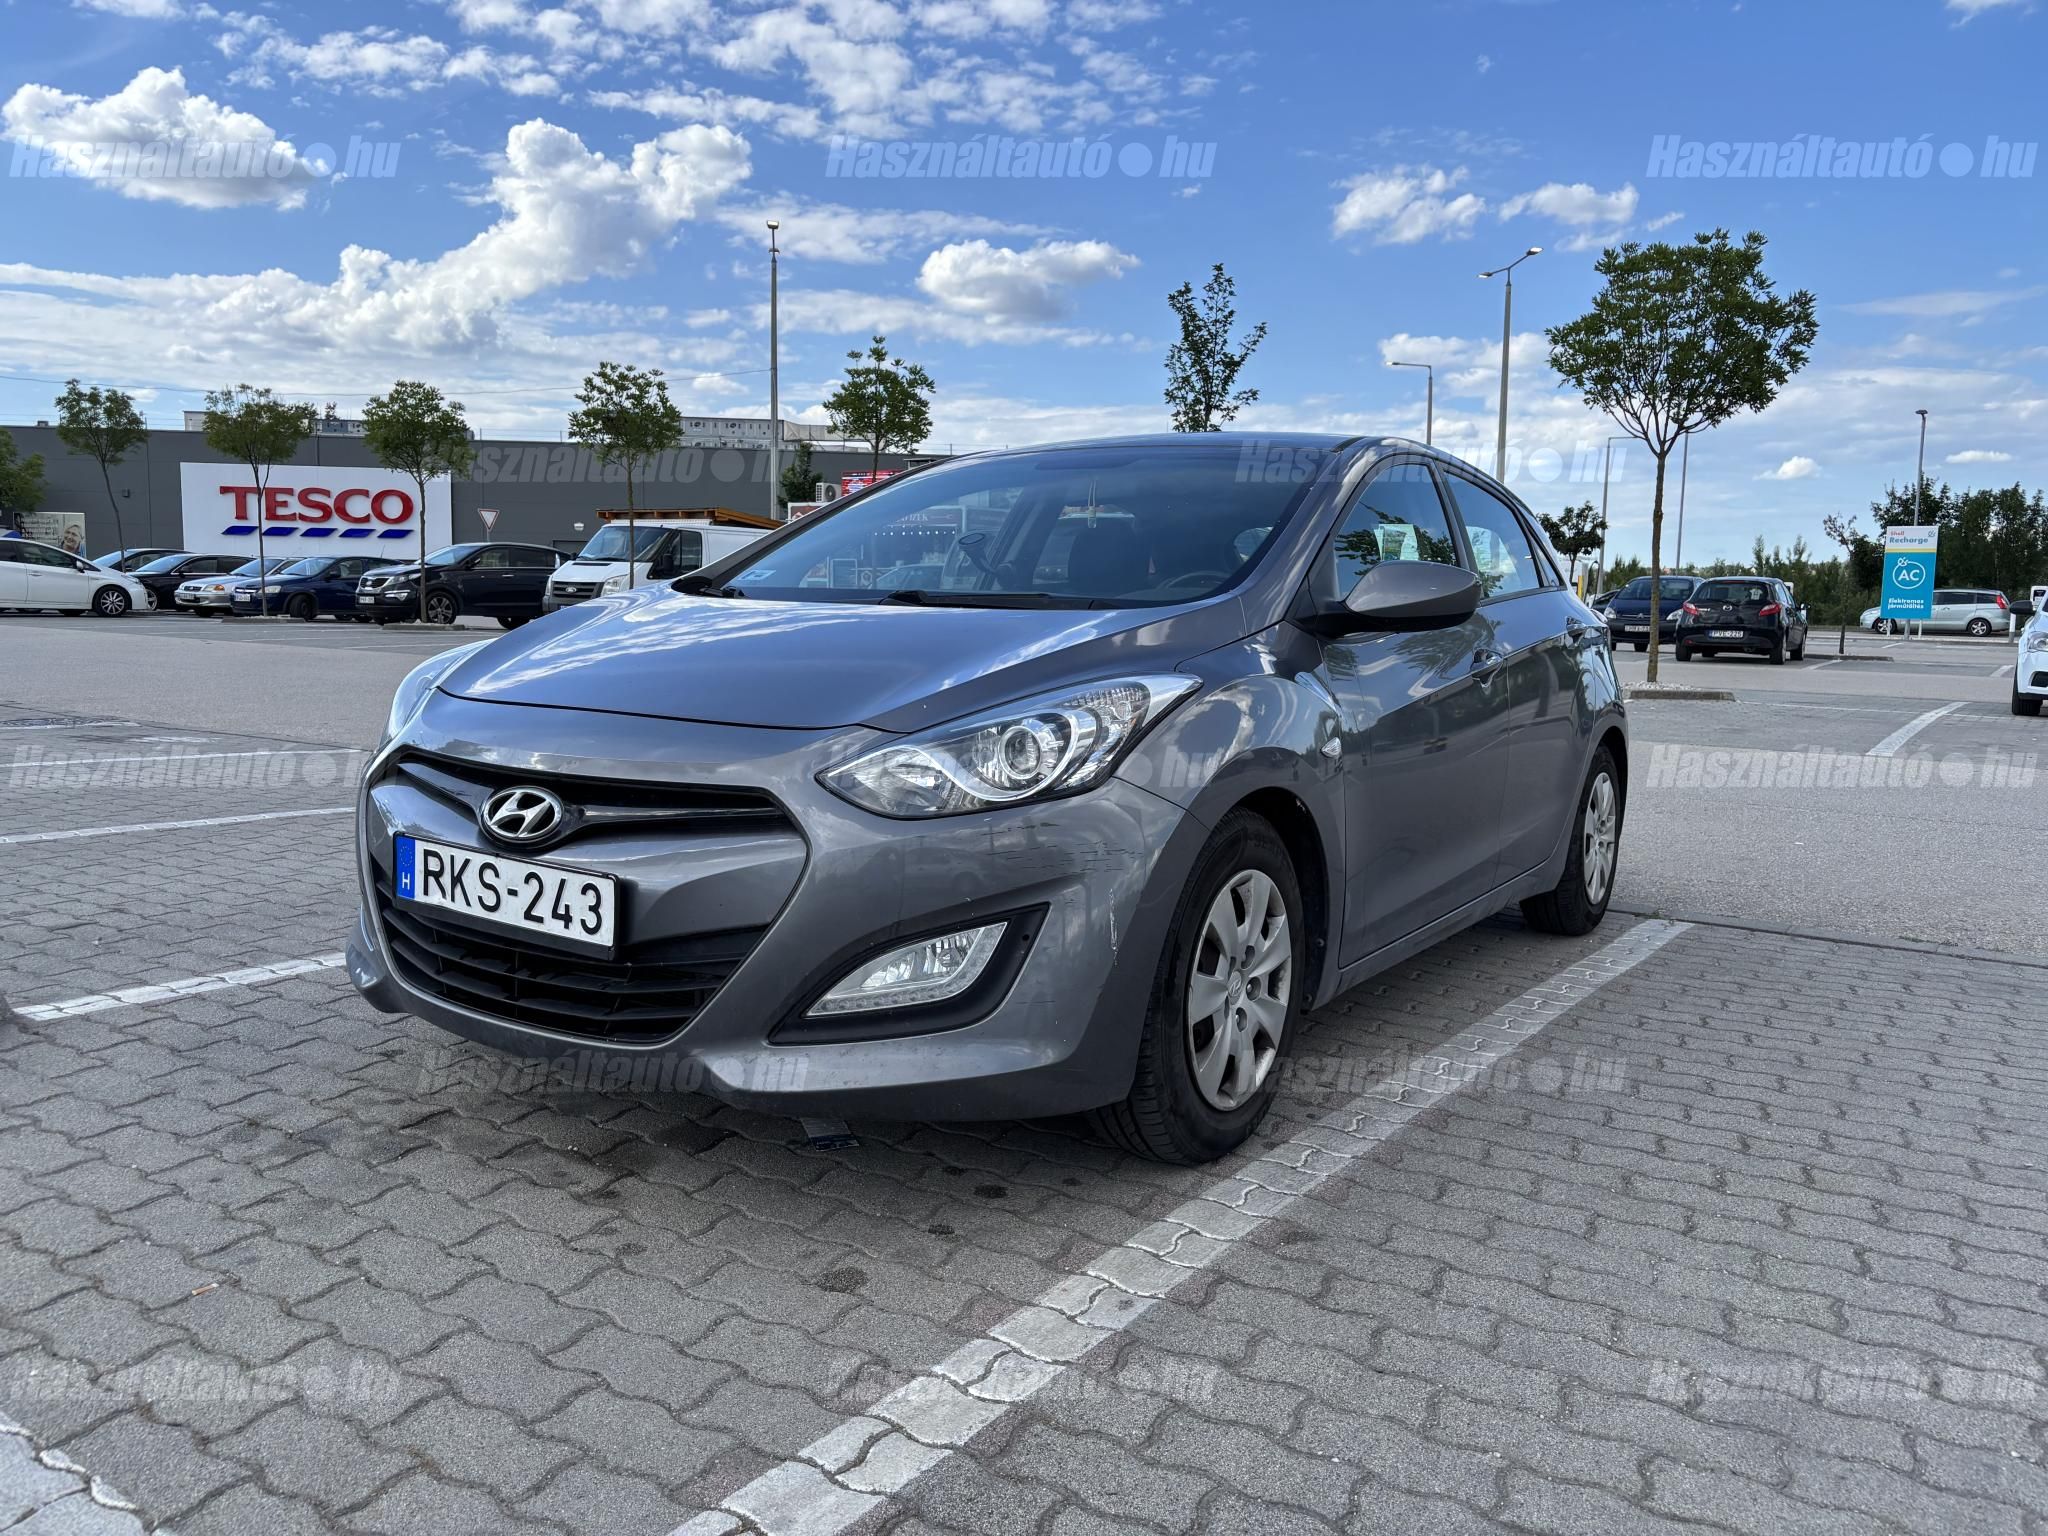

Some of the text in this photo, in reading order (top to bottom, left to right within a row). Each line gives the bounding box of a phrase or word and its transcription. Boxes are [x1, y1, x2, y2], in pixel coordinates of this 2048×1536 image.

[219, 485, 414, 524] TESCO
[1889, 536, 1929, 545] Recharge
[1898, 569, 1920, 581] AC
[402, 871, 411, 890] H
[422, 848, 603, 936] RKS-243
